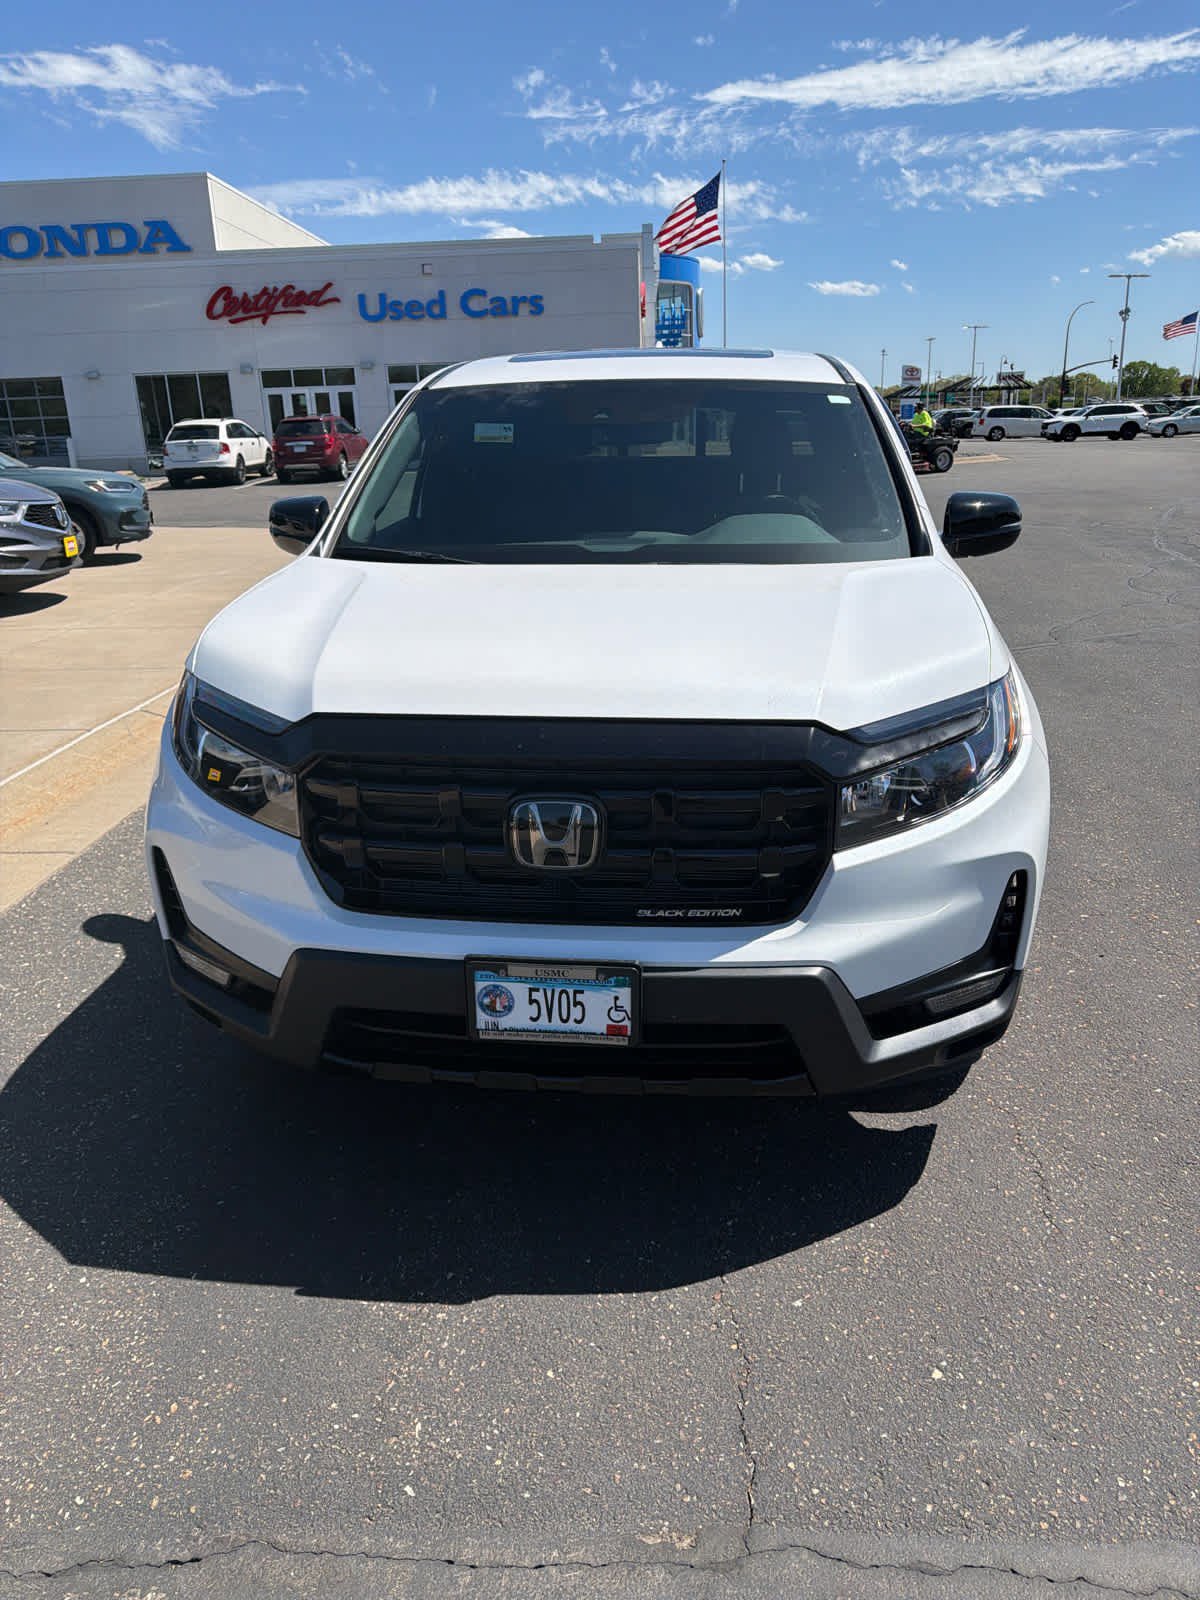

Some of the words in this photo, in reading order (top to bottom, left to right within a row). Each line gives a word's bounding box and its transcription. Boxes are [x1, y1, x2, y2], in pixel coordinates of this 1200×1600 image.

[206, 282, 340, 324] Certified
[358, 290, 448, 323] Used
[459, 288, 544, 318] Cars
[636, 908, 685, 917] BLACK
[687, 908, 743, 917] EDITION
[535, 968, 571, 978] USMC
[528, 987, 586, 1025] 5V05
